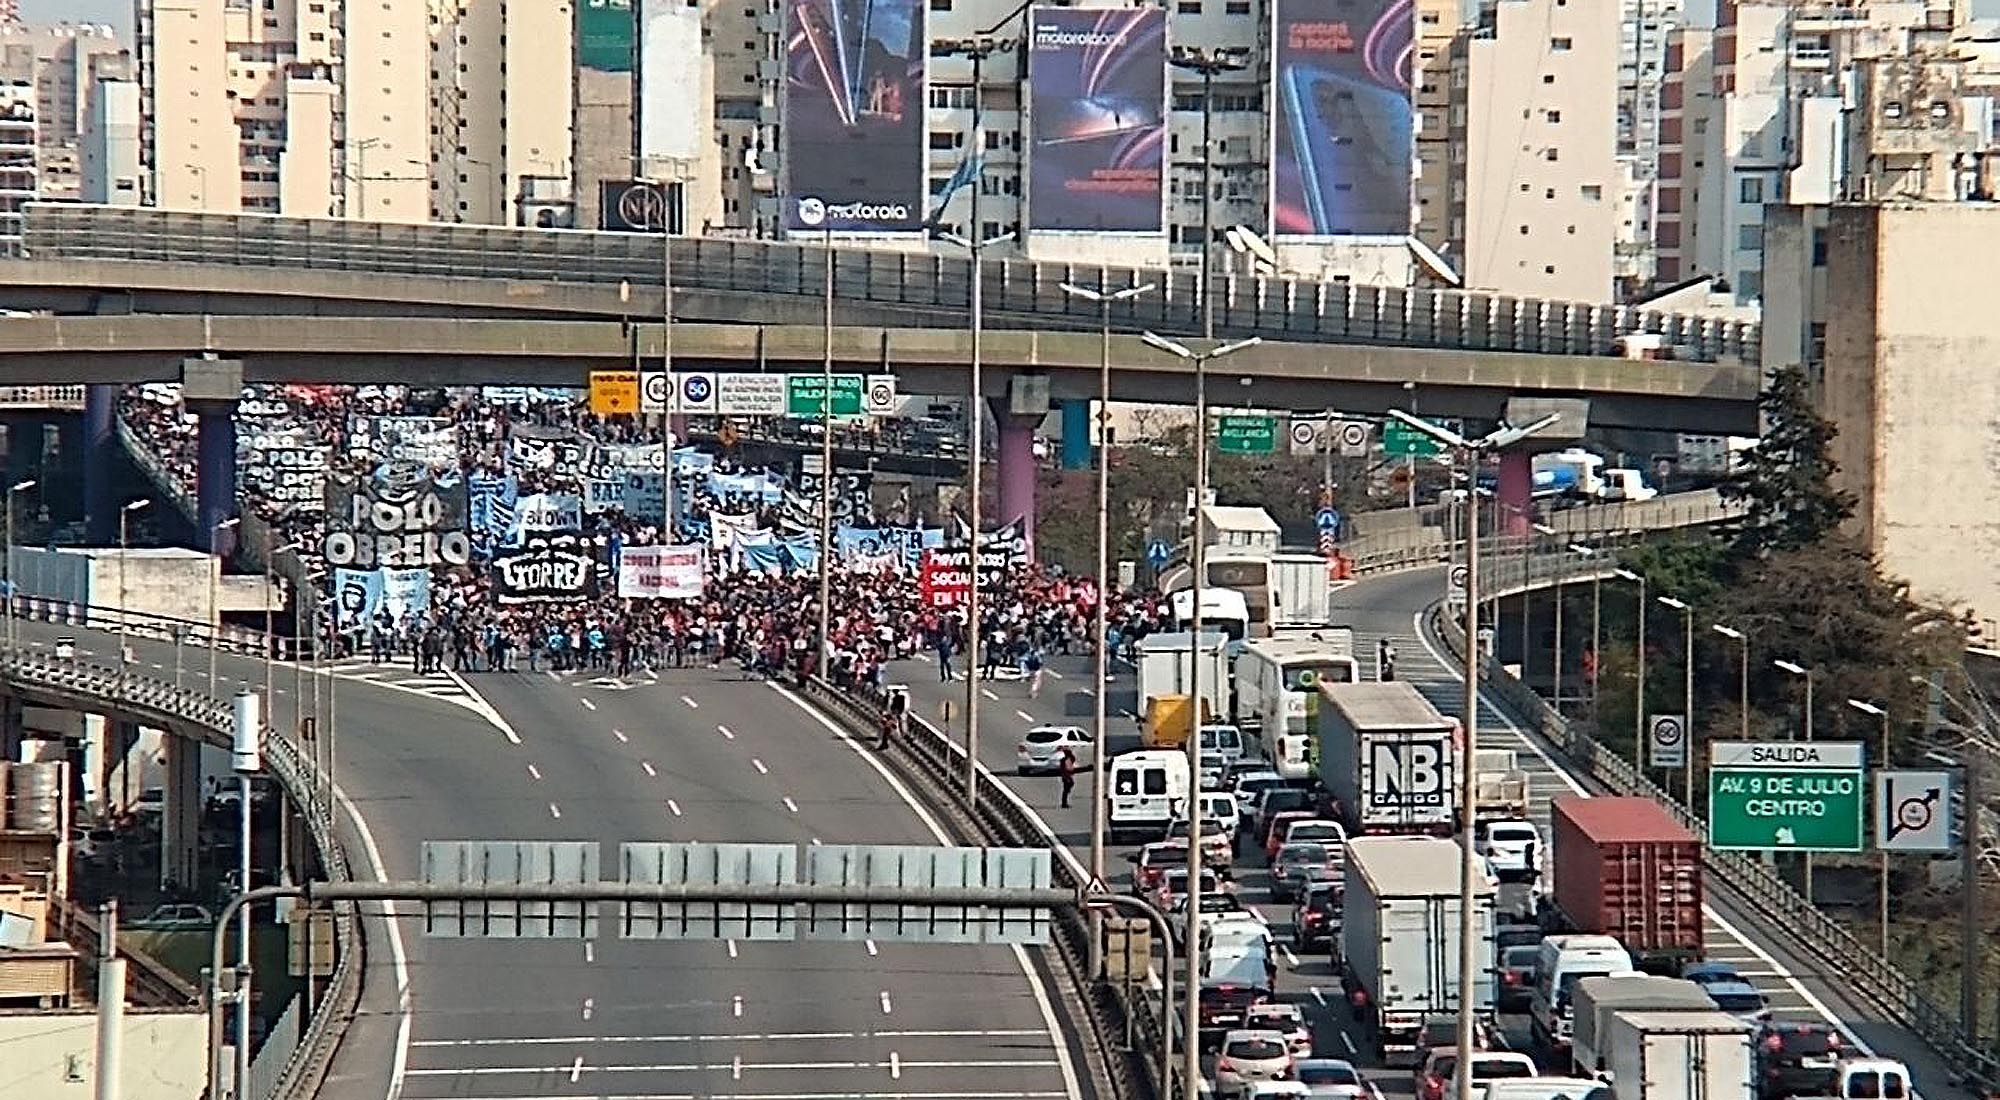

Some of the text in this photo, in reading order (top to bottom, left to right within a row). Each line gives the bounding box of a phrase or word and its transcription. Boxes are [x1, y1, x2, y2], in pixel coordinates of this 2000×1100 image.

[827, 201, 908, 220] motorola
[687, 381, 709, 397] 50
[269, 451, 324, 467] POLO
[353, 492, 441, 532] POLO
[326, 531, 469, 566] OBRERO
[1751, 747, 1820, 763] SALIDA
[1375, 744, 1440, 794] NB
[1719, 778, 1853, 795] AV. 9 DE JULIO
[1374, 793, 1440, 804] CARGO
[1745, 799, 1826, 816] CENTRO
